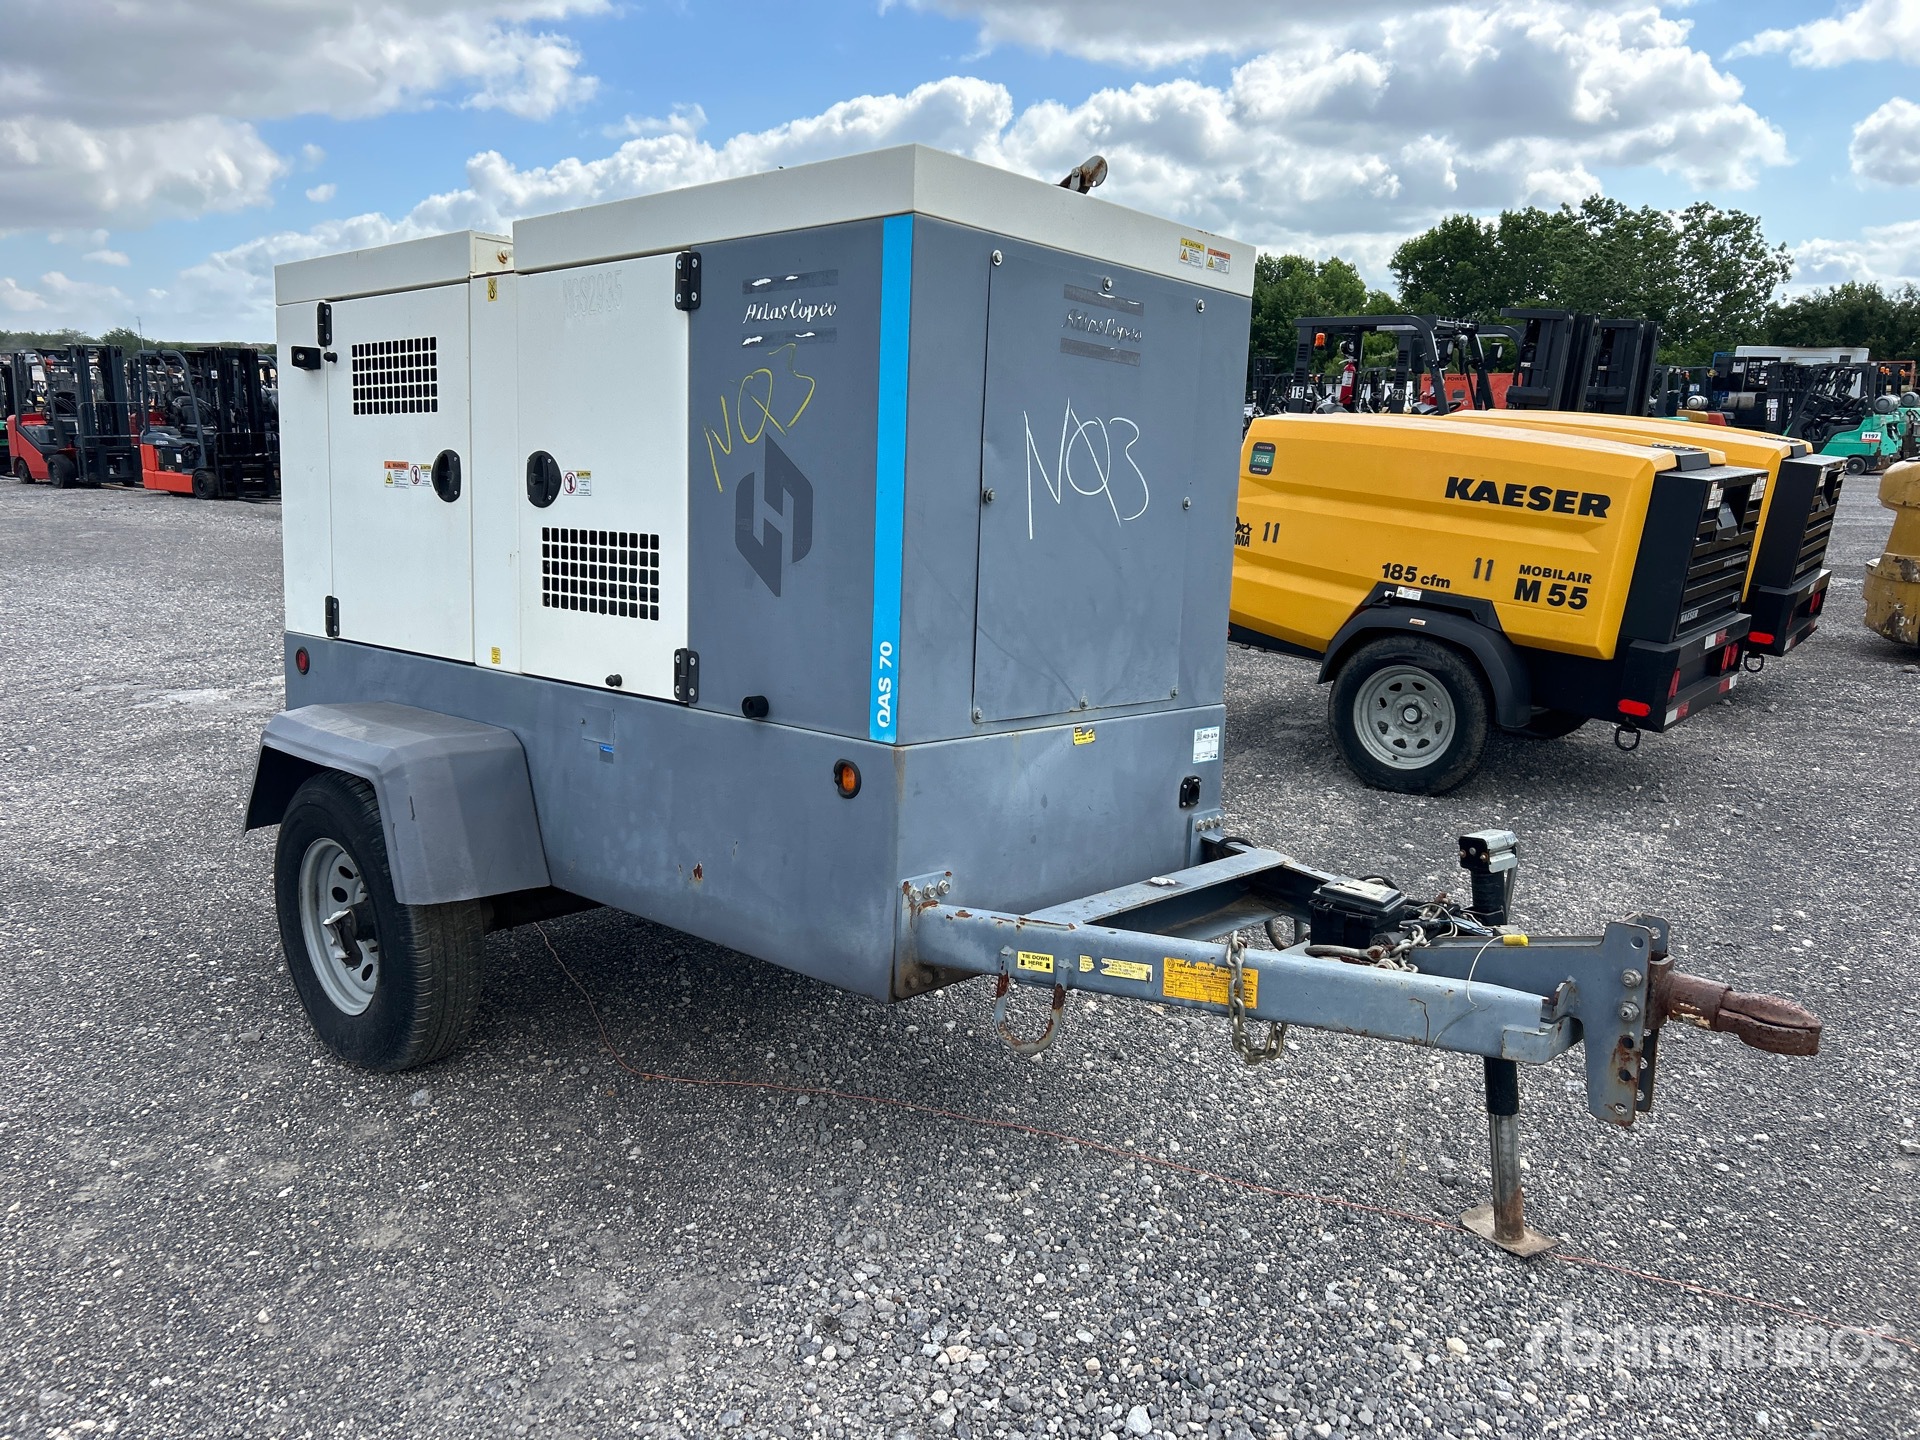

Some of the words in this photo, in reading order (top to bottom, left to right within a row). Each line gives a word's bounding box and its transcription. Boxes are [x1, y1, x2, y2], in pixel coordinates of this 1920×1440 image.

[1023, 397, 1149, 540] NQ3
[1444, 476, 1611, 518] KAESER
[1234, 533, 1250, 547] MA
[1262, 521, 1280, 543] 11
[1382, 562, 1418, 582] 185
[1420, 574, 1451, 588] cfm
[1473, 557, 1494, 581] 11
[1519, 564, 1592, 584] MOBILAIR
[1514, 578, 1542, 603] M
[1546, 583, 1589, 610] 55
[879, 641, 893, 669] 70
[876, 677, 892, 728] QAS
